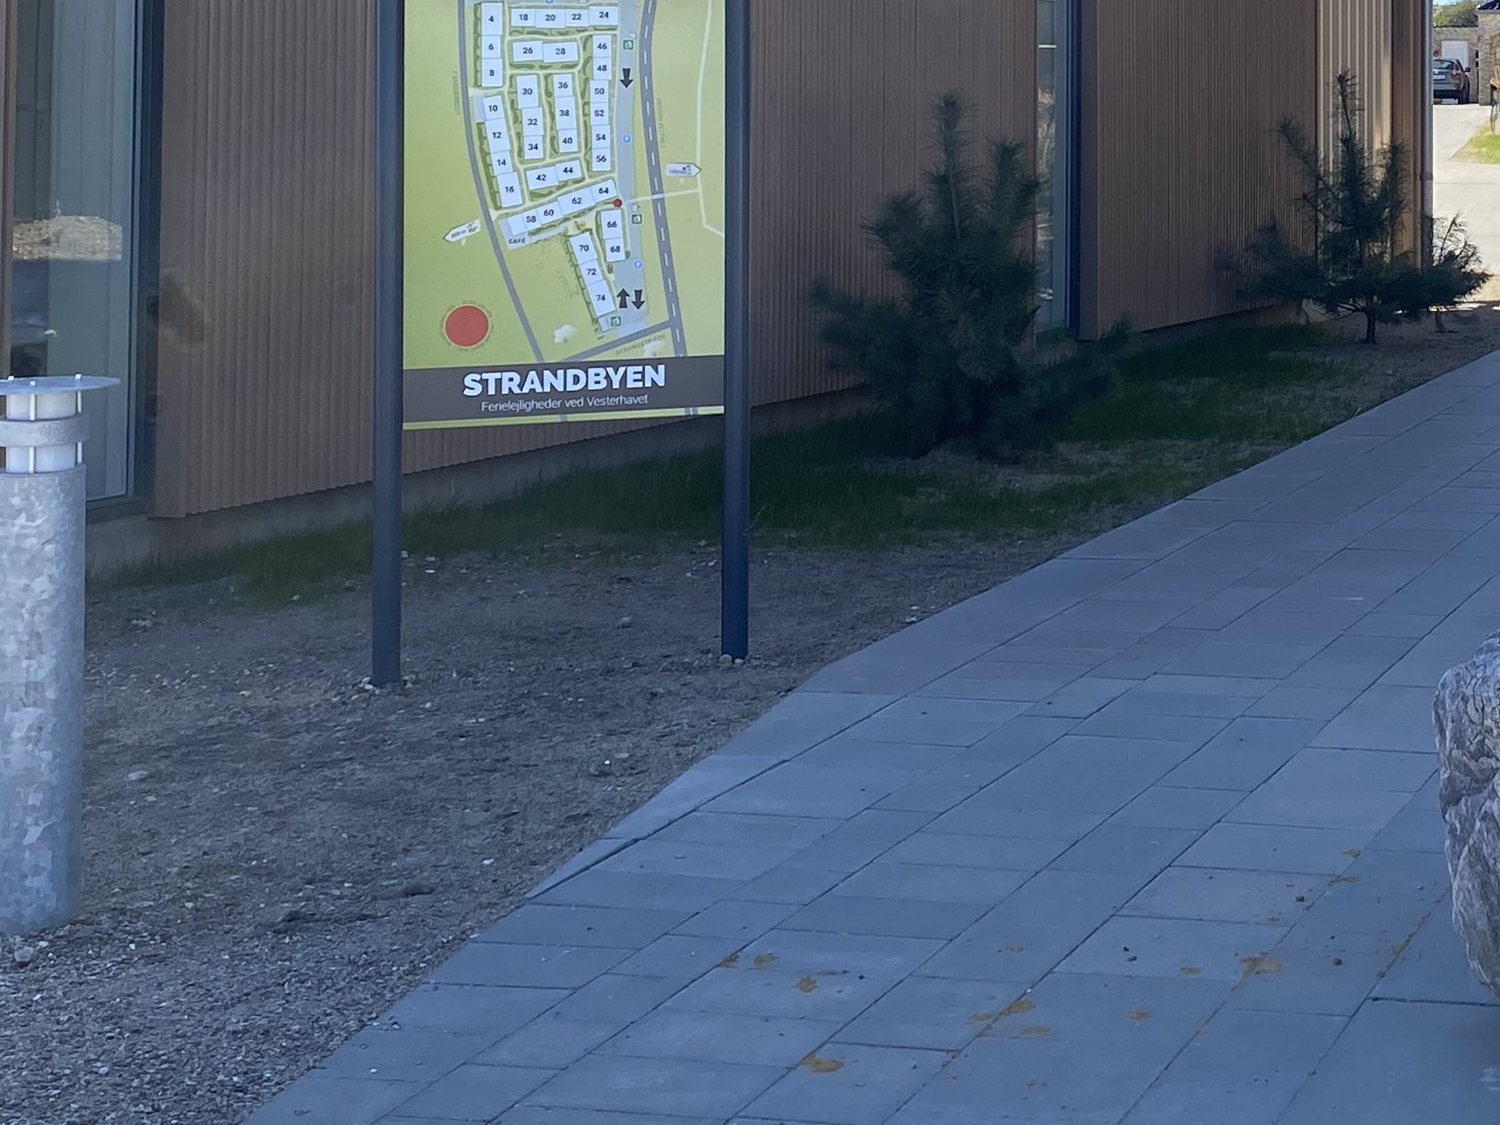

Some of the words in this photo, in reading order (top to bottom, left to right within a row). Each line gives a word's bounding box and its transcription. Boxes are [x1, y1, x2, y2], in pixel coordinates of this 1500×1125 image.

[463, 365, 665, 396] STRANDBYEN
[481, 397, 562, 413] Ferielejligheder
[565, 399, 584, 408] ved
[587, 394, 648, 407] Vesterhavet
